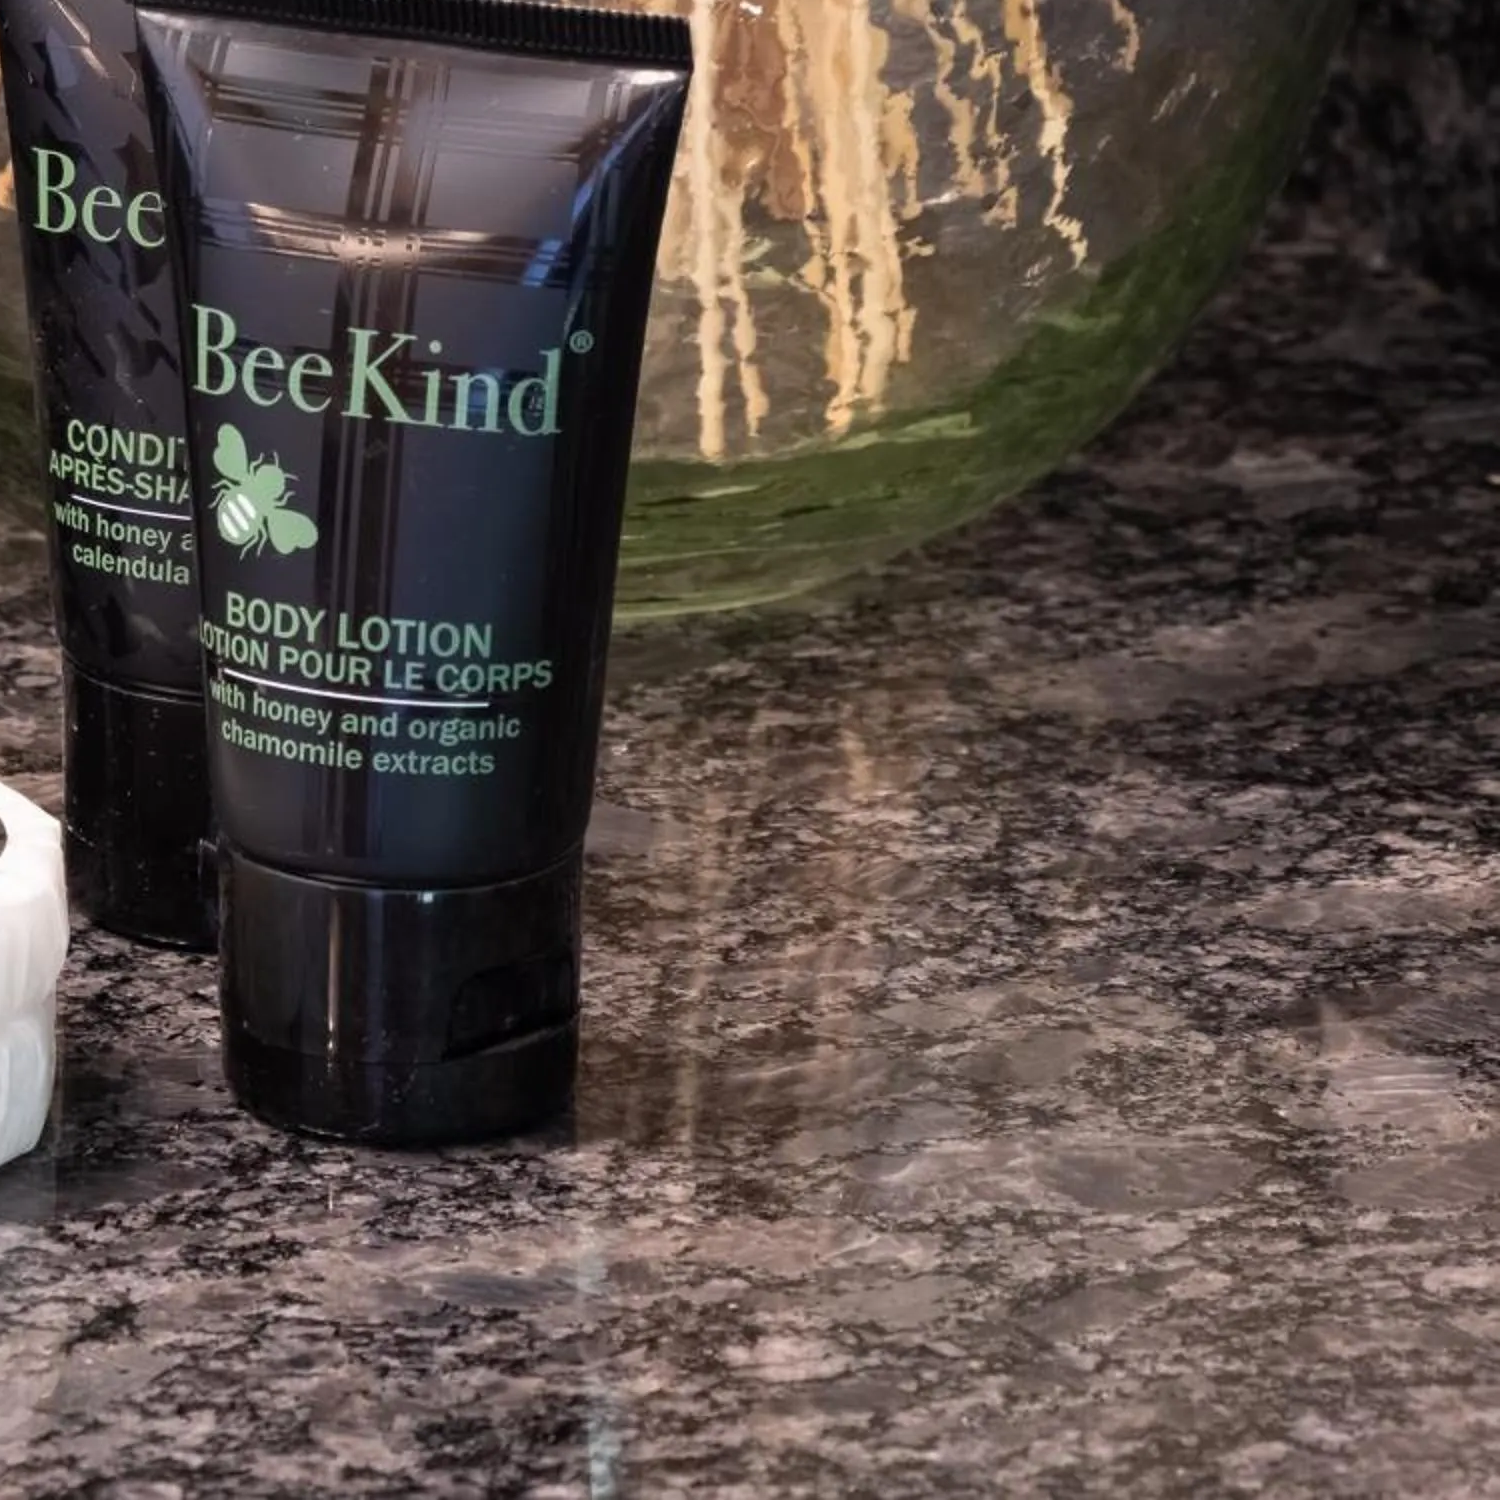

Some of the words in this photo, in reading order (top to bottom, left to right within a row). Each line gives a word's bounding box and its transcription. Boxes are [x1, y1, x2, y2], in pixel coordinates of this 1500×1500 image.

[53, 501, 89, 533] with
[97, 513, 172, 553] honey
[72, 544, 190, 585] calendula
[200, 615, 269, 670] LOTION
[279, 645, 372, 687] POUR
[384, 660, 425, 691] LE
[436, 660, 553, 694] CORPS
[226, 590, 326, 643] BODY
[337, 613, 493, 659] LOTION
[210, 677, 245, 711] with
[253, 691, 332, 735] honey
[341, 711, 398, 738] and
[408, 712, 521, 746] organic
[222, 718, 363, 770] chamomile
[373, 747, 495, 775] extracts
